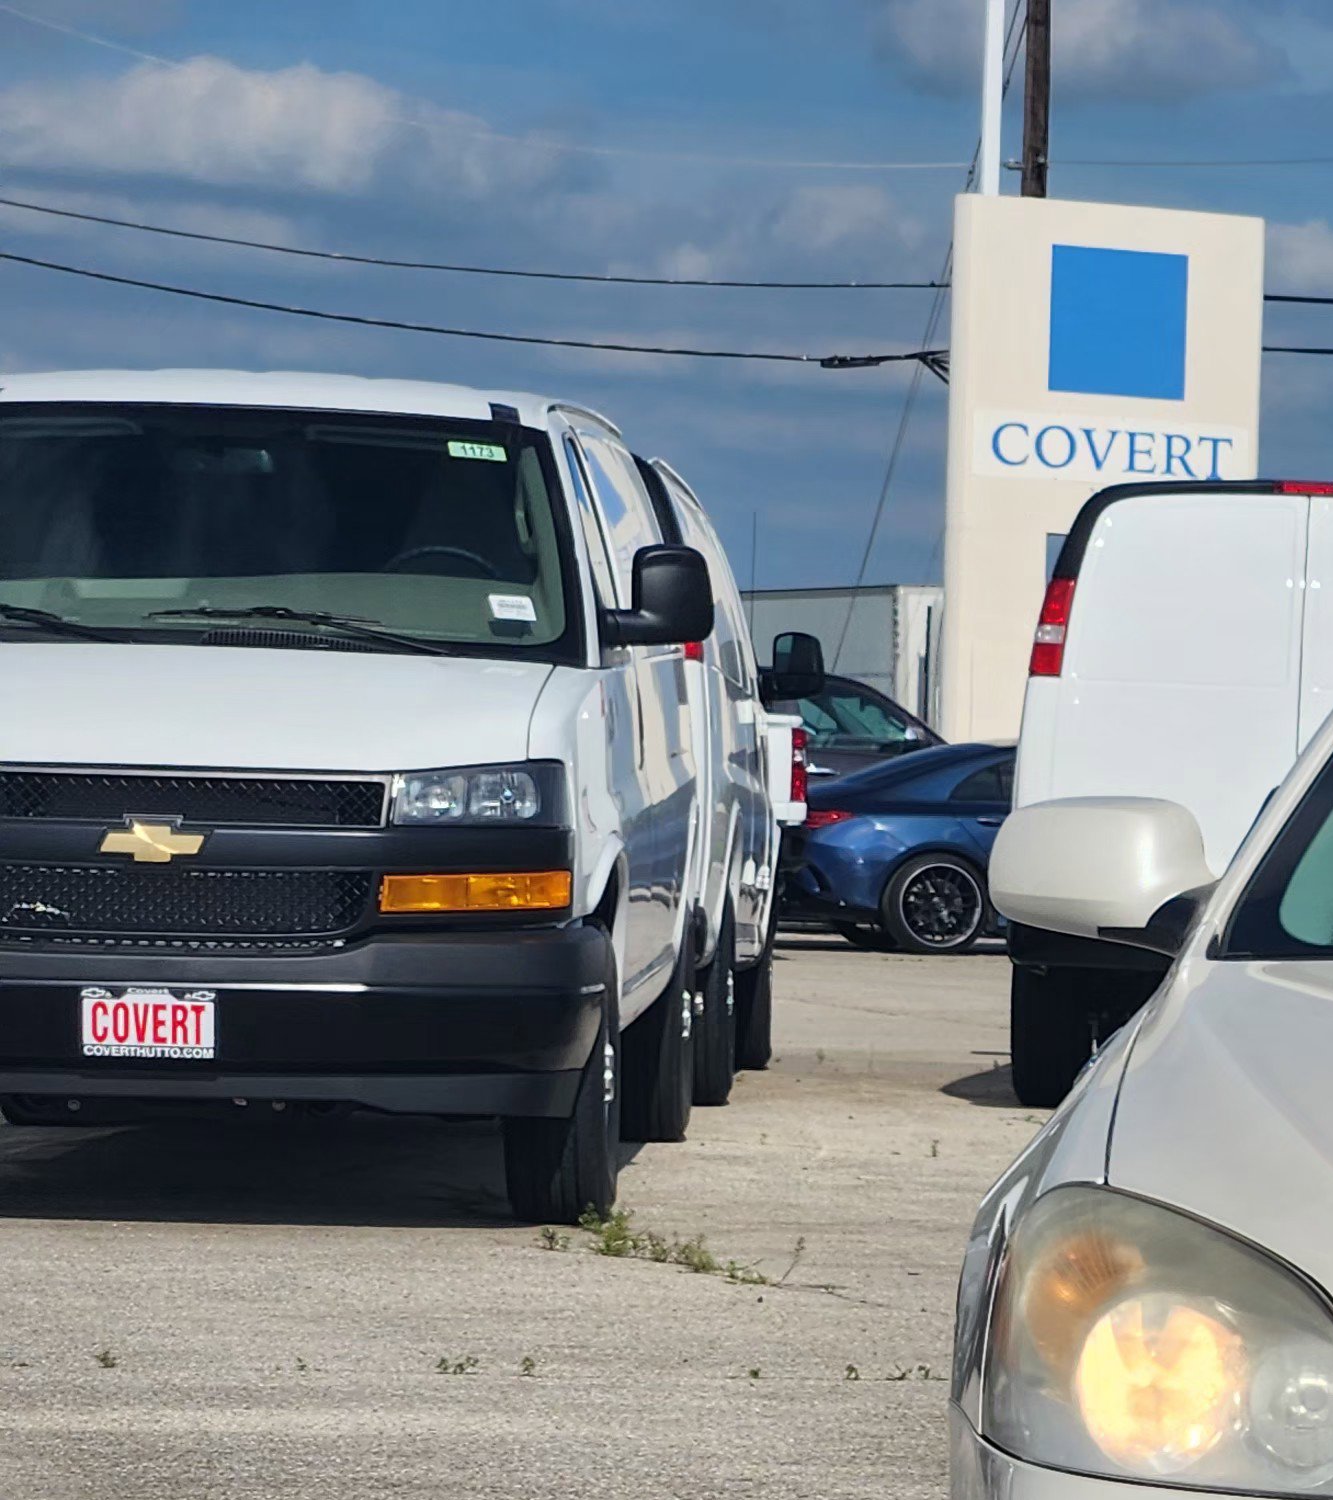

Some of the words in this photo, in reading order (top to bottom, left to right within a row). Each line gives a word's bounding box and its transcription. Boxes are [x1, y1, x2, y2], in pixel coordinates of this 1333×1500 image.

[992, 422, 1233, 481] COVERT
[91, 1001, 206, 1045] COVERT
[82, 1045, 215, 1059] COVERTHUTTO.COM
